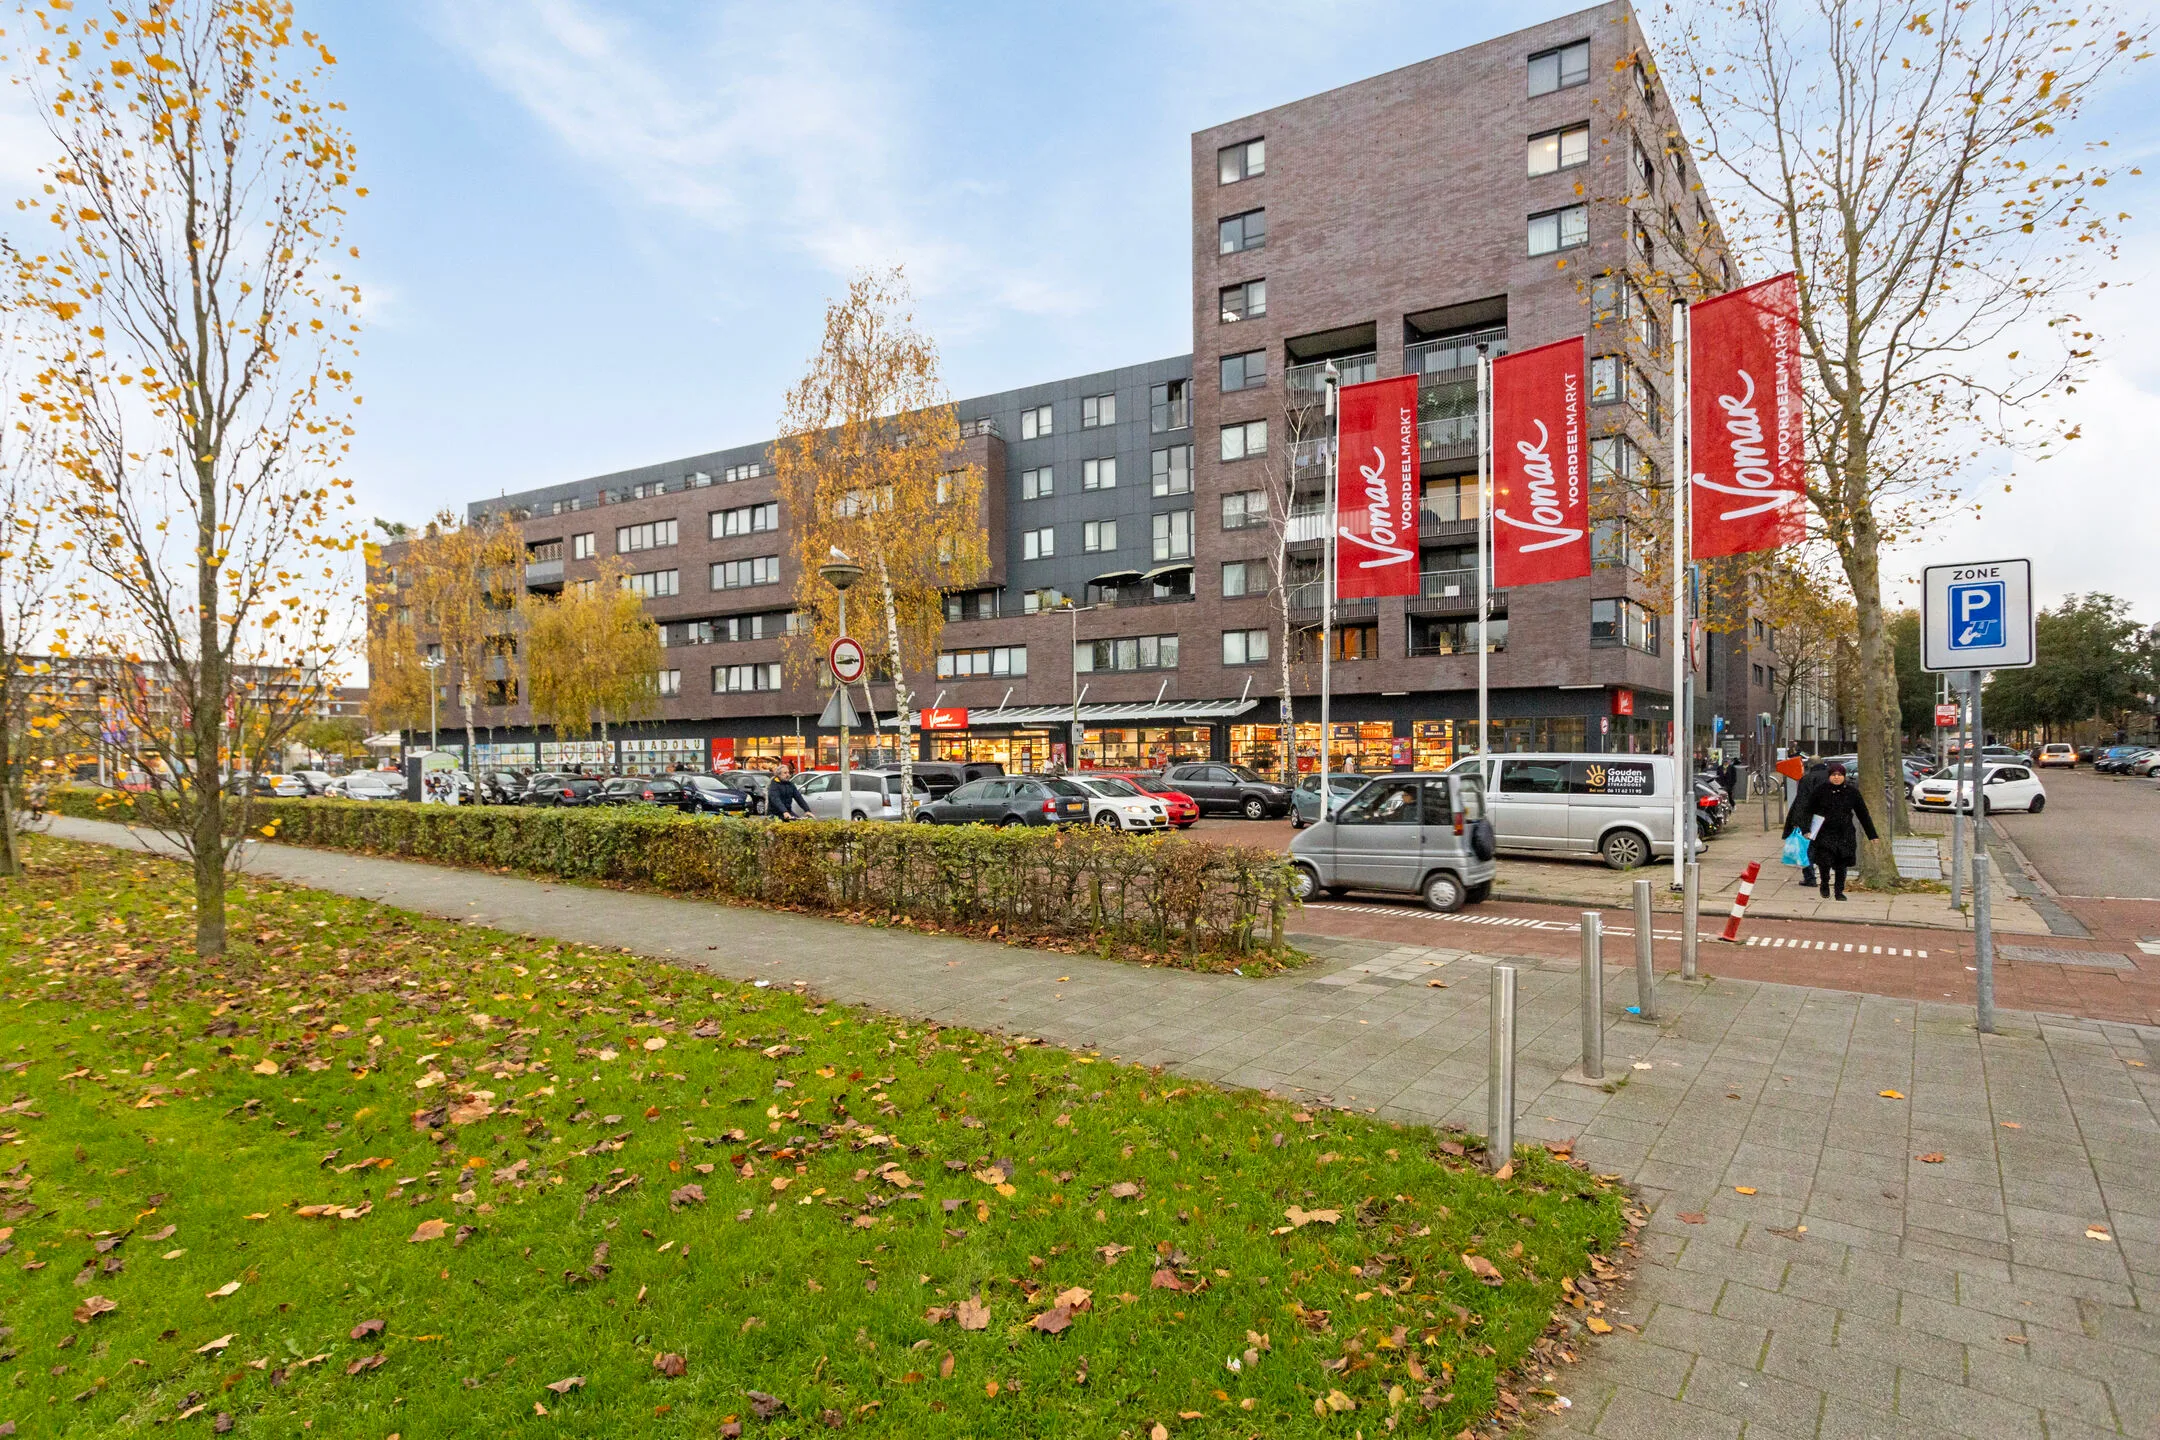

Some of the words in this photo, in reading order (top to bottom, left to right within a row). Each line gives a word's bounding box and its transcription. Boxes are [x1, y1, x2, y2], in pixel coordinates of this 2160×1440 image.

[1564, 372, 1580, 508] VOORDEELMARKT
[1774, 315, 1790, 467] VOORDEELMARKT
[1339, 446, 1415, 569] Vomar
[1400, 407, 1413, 531] VOORDEELMARKT
[1495, 418, 1584, 554] Vomar
[1953, 567, 2000, 581] ZONE
[1961, 589, 1992, 622] P
[627, 739, 700, 751] ANADOLU
[1607, 768, 1642, 776] Gouden
